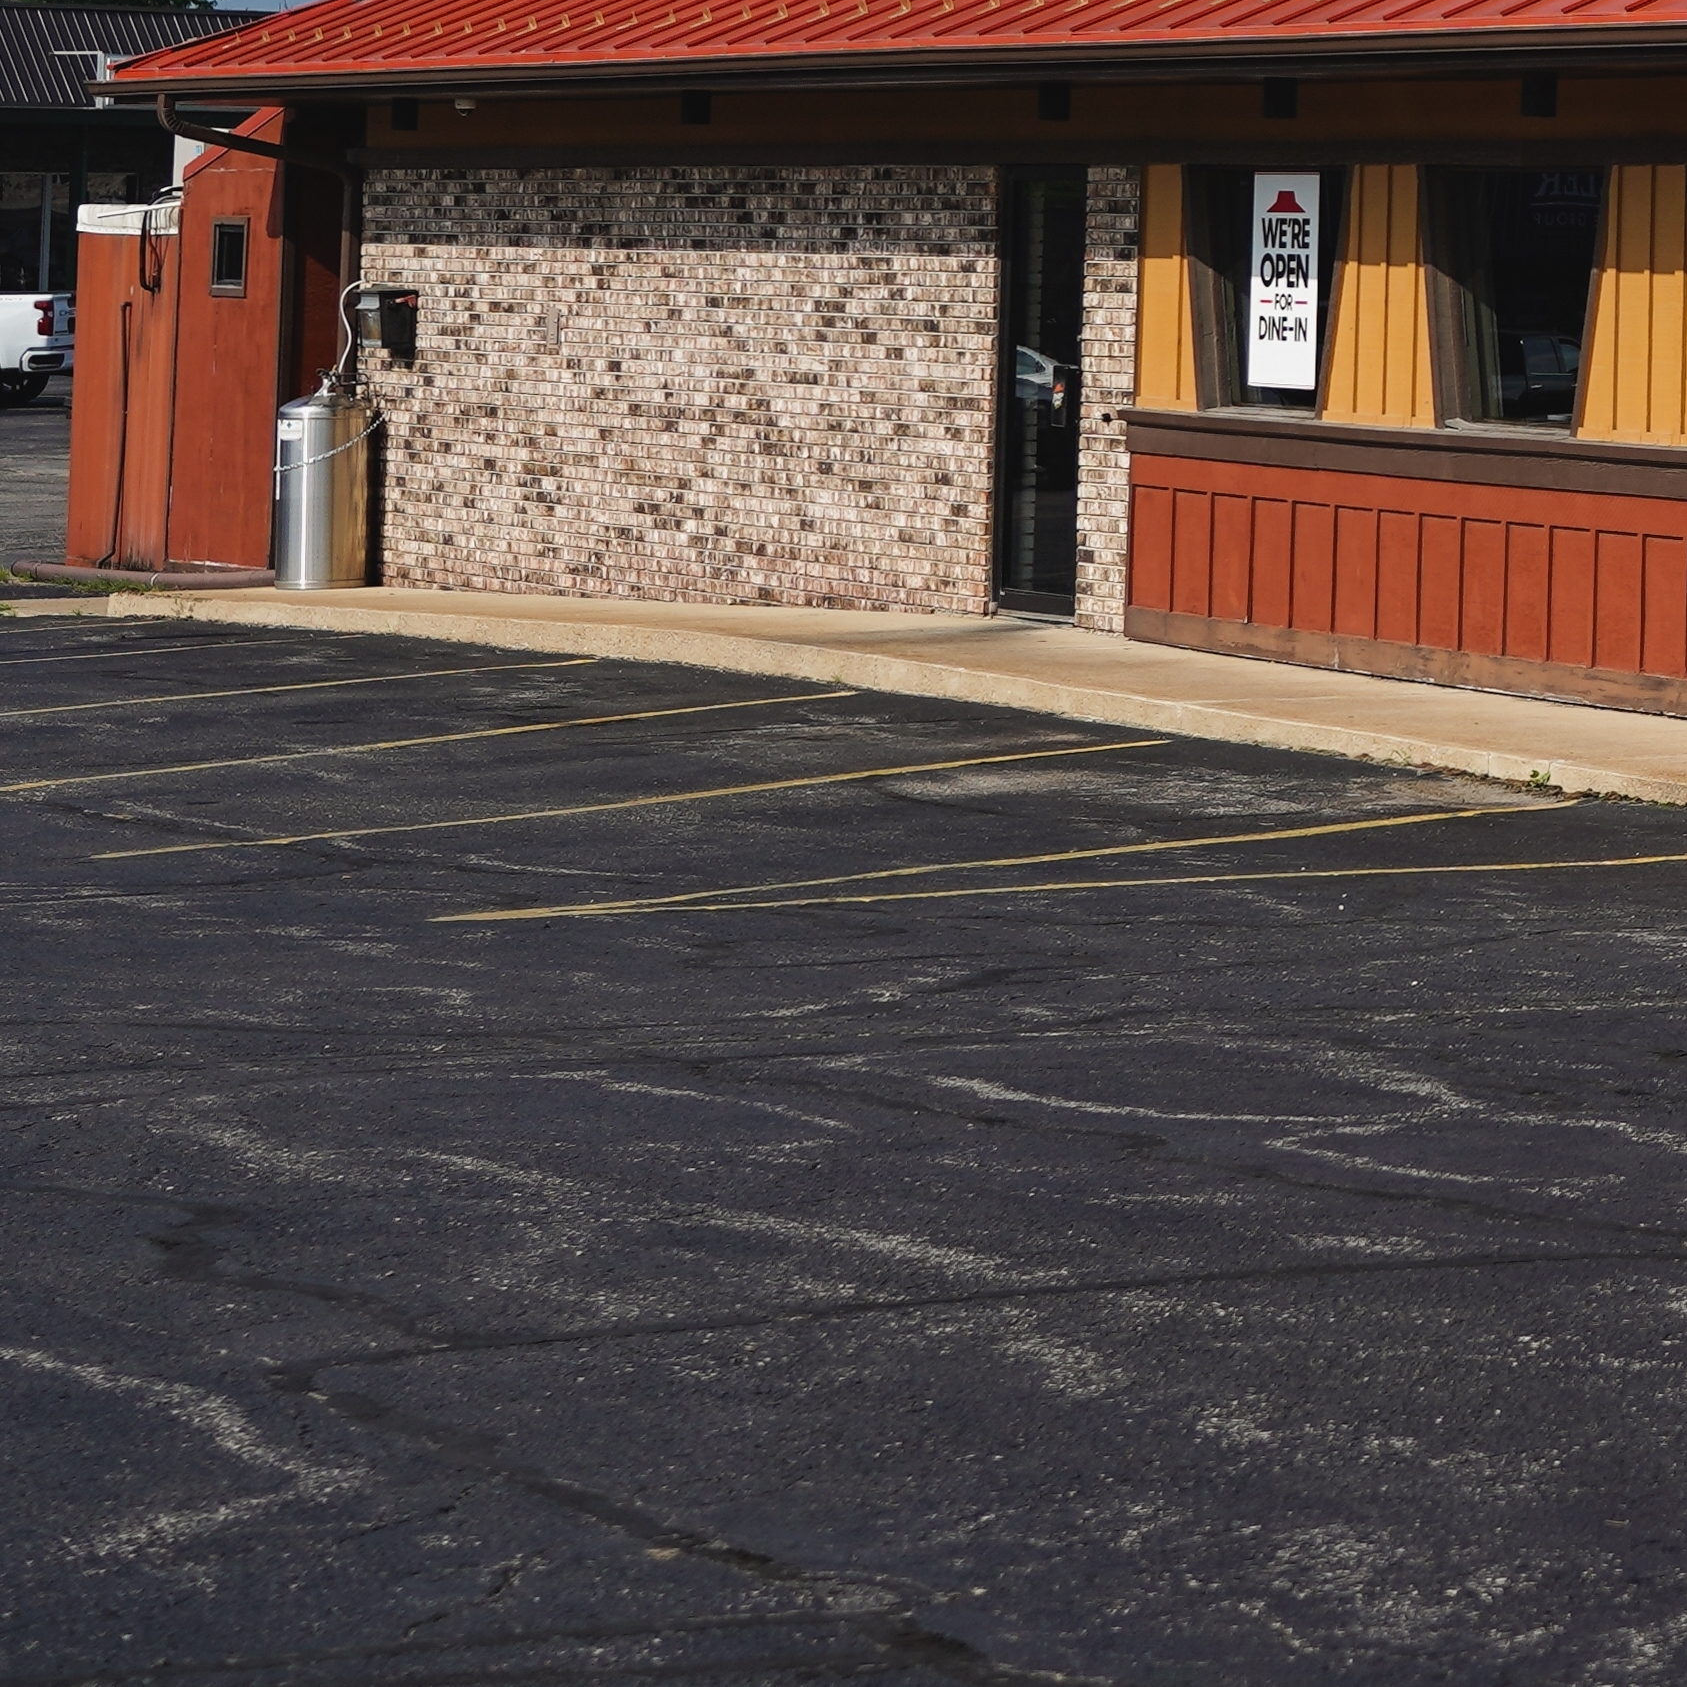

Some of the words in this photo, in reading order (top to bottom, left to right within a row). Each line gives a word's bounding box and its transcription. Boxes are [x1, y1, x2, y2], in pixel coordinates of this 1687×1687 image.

[1261, 217, 1311, 249] WE'RE
[1260, 253, 1310, 289] OPEN
[1274, 293, 1293, 311] FOR
[1258, 316, 1308, 342] DINE-IN
